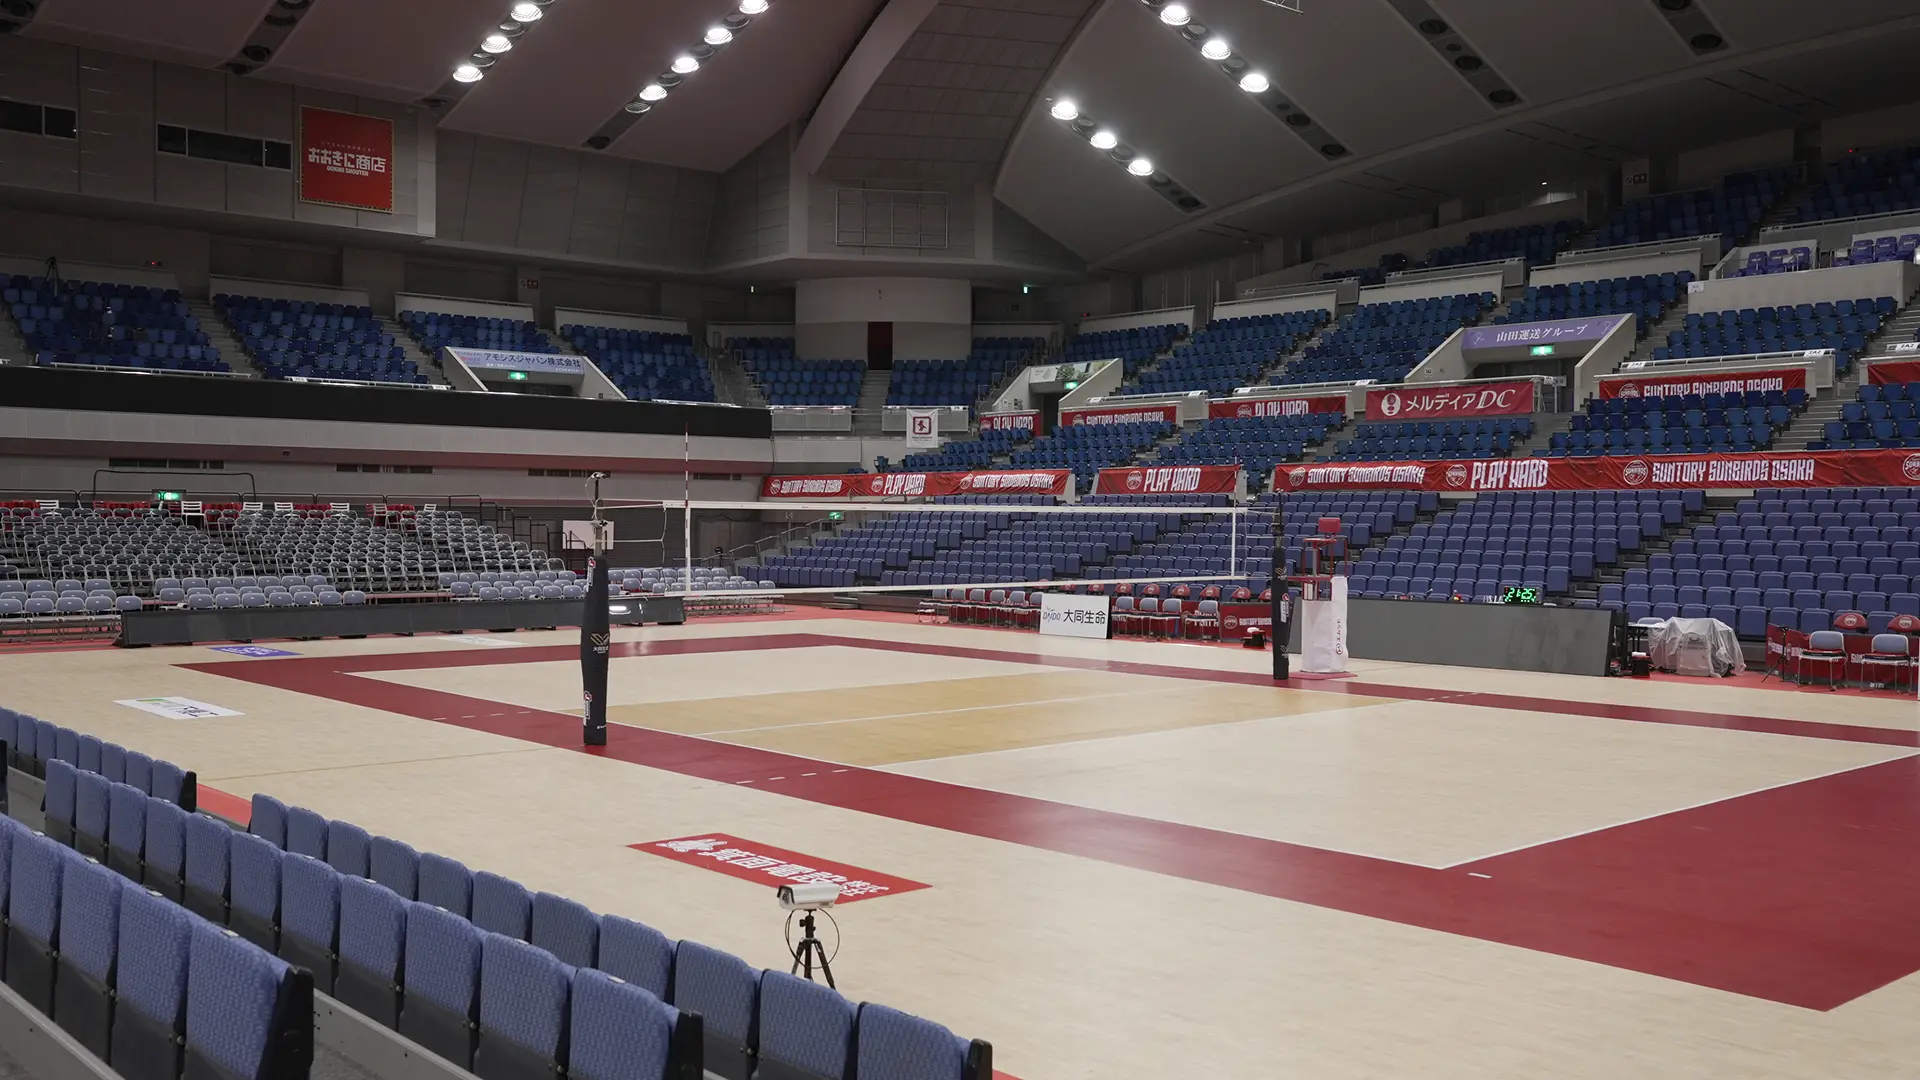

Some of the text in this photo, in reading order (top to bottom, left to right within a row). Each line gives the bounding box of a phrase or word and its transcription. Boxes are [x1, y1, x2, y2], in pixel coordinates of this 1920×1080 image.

[308, 147, 387, 173] おおきに商店
[1496, 324, 1588, 343] 山田運送グループ
[483, 352, 582, 368] アモシスジャパン株式会社
[1143, 467, 1202, 492] PLAY HARD
[1307, 465, 1426, 484] SUNTORY SUNBIRDS OSAKA
[1470, 459, 1549, 489] PLAY HARD
[1652, 459, 1815, 483] SUNTORY SUNBIRDS OSAKA
[883, 474, 927, 495] PLAY HARD
[1063, 609, 1107, 625] 大同生命
